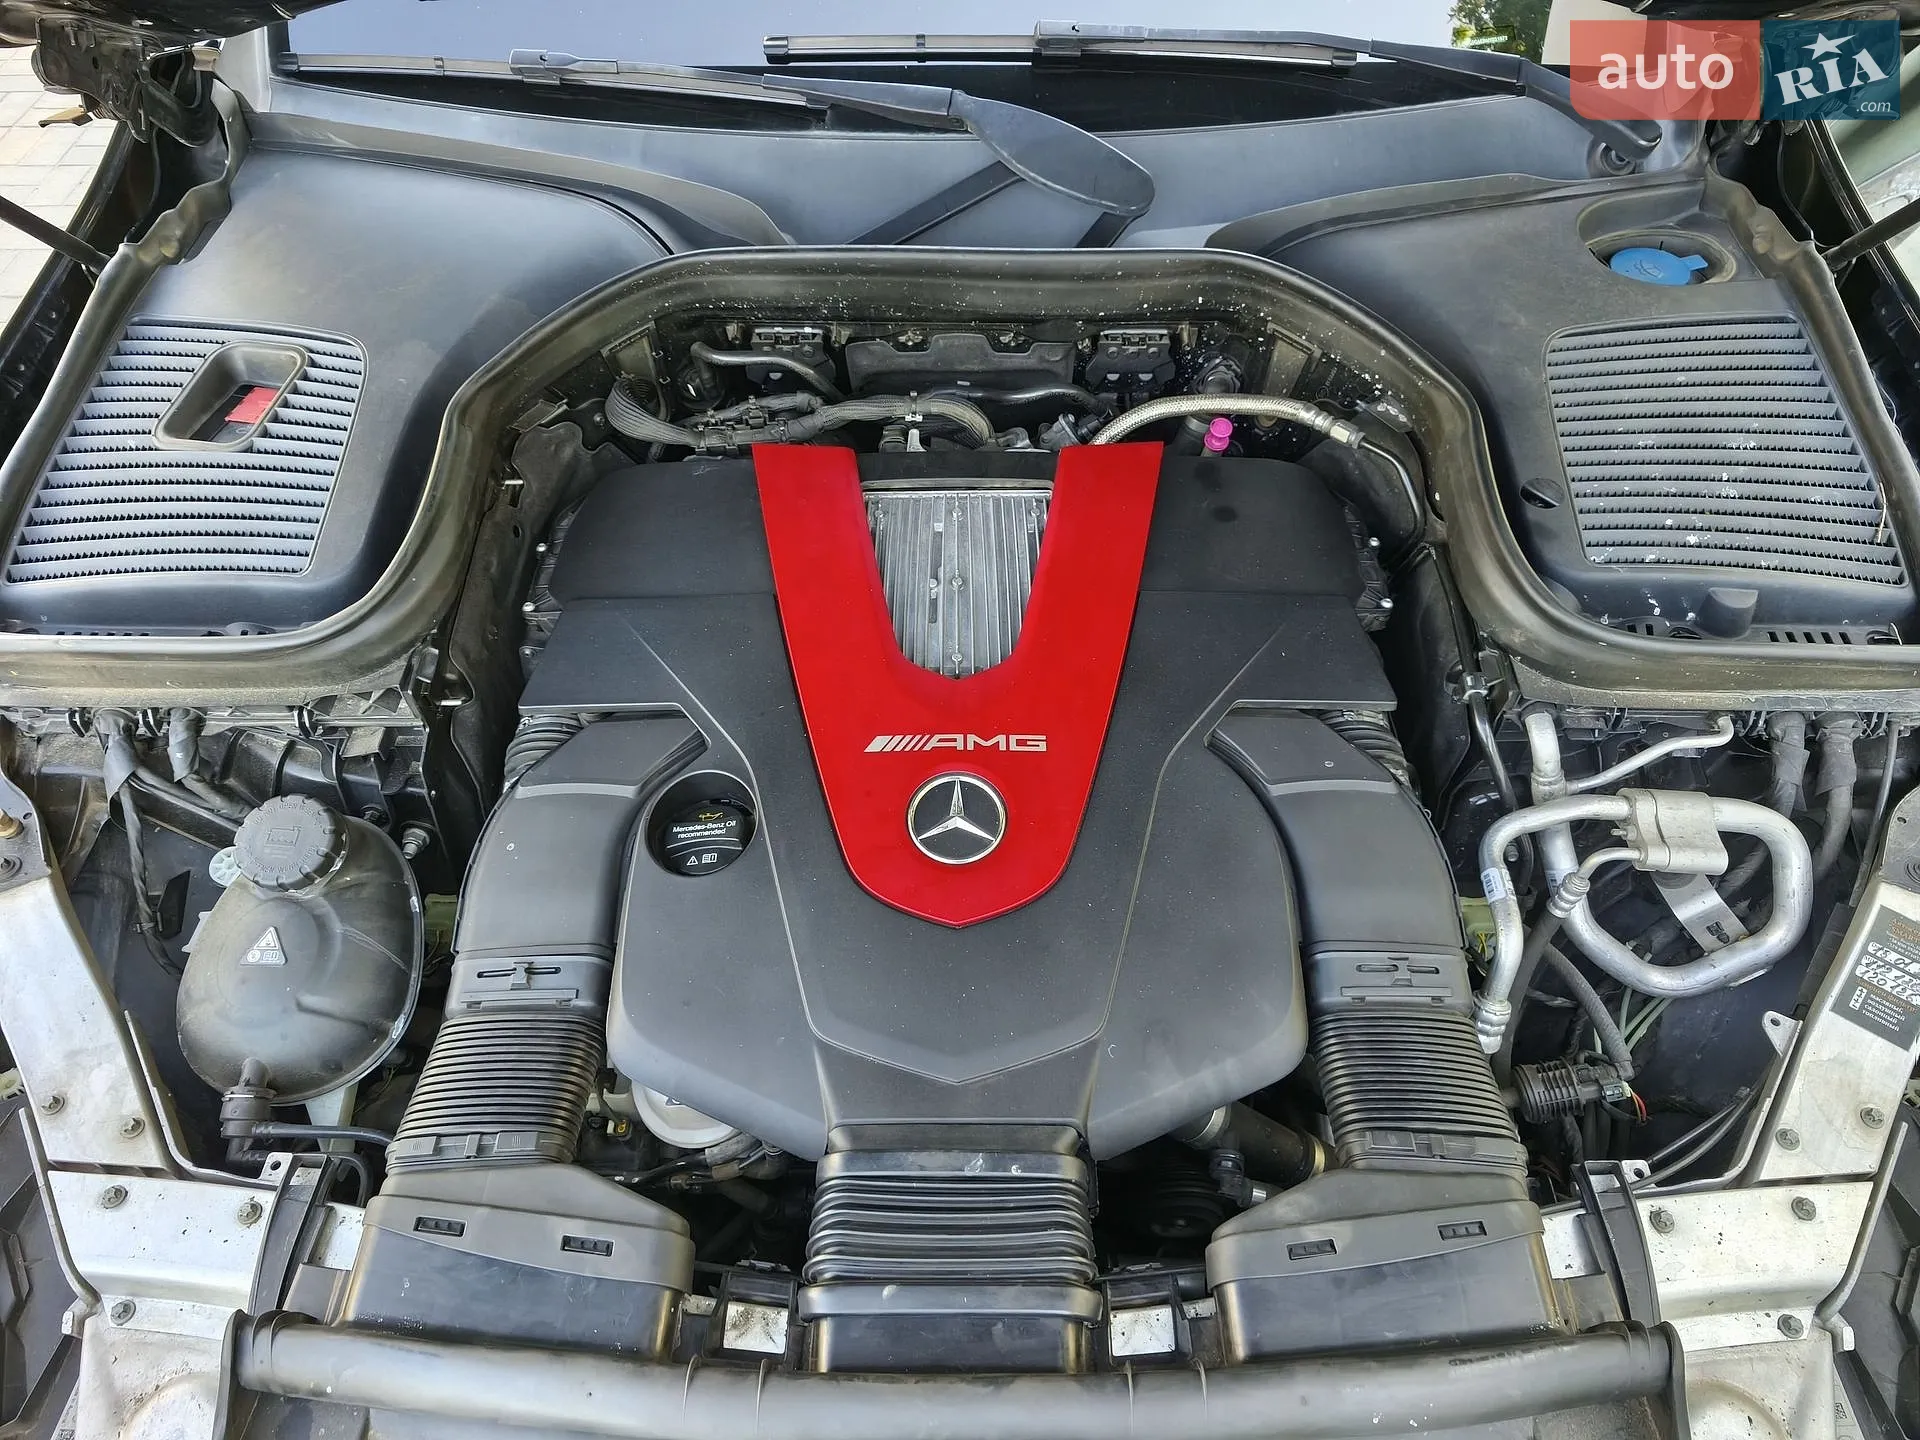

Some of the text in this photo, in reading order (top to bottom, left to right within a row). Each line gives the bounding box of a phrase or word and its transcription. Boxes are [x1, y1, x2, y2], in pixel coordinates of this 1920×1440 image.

[922, 733, 1047, 752] AMG
[672, 821, 725, 833] Mercedes-Benz
[677, 828, 726, 839] recommended
